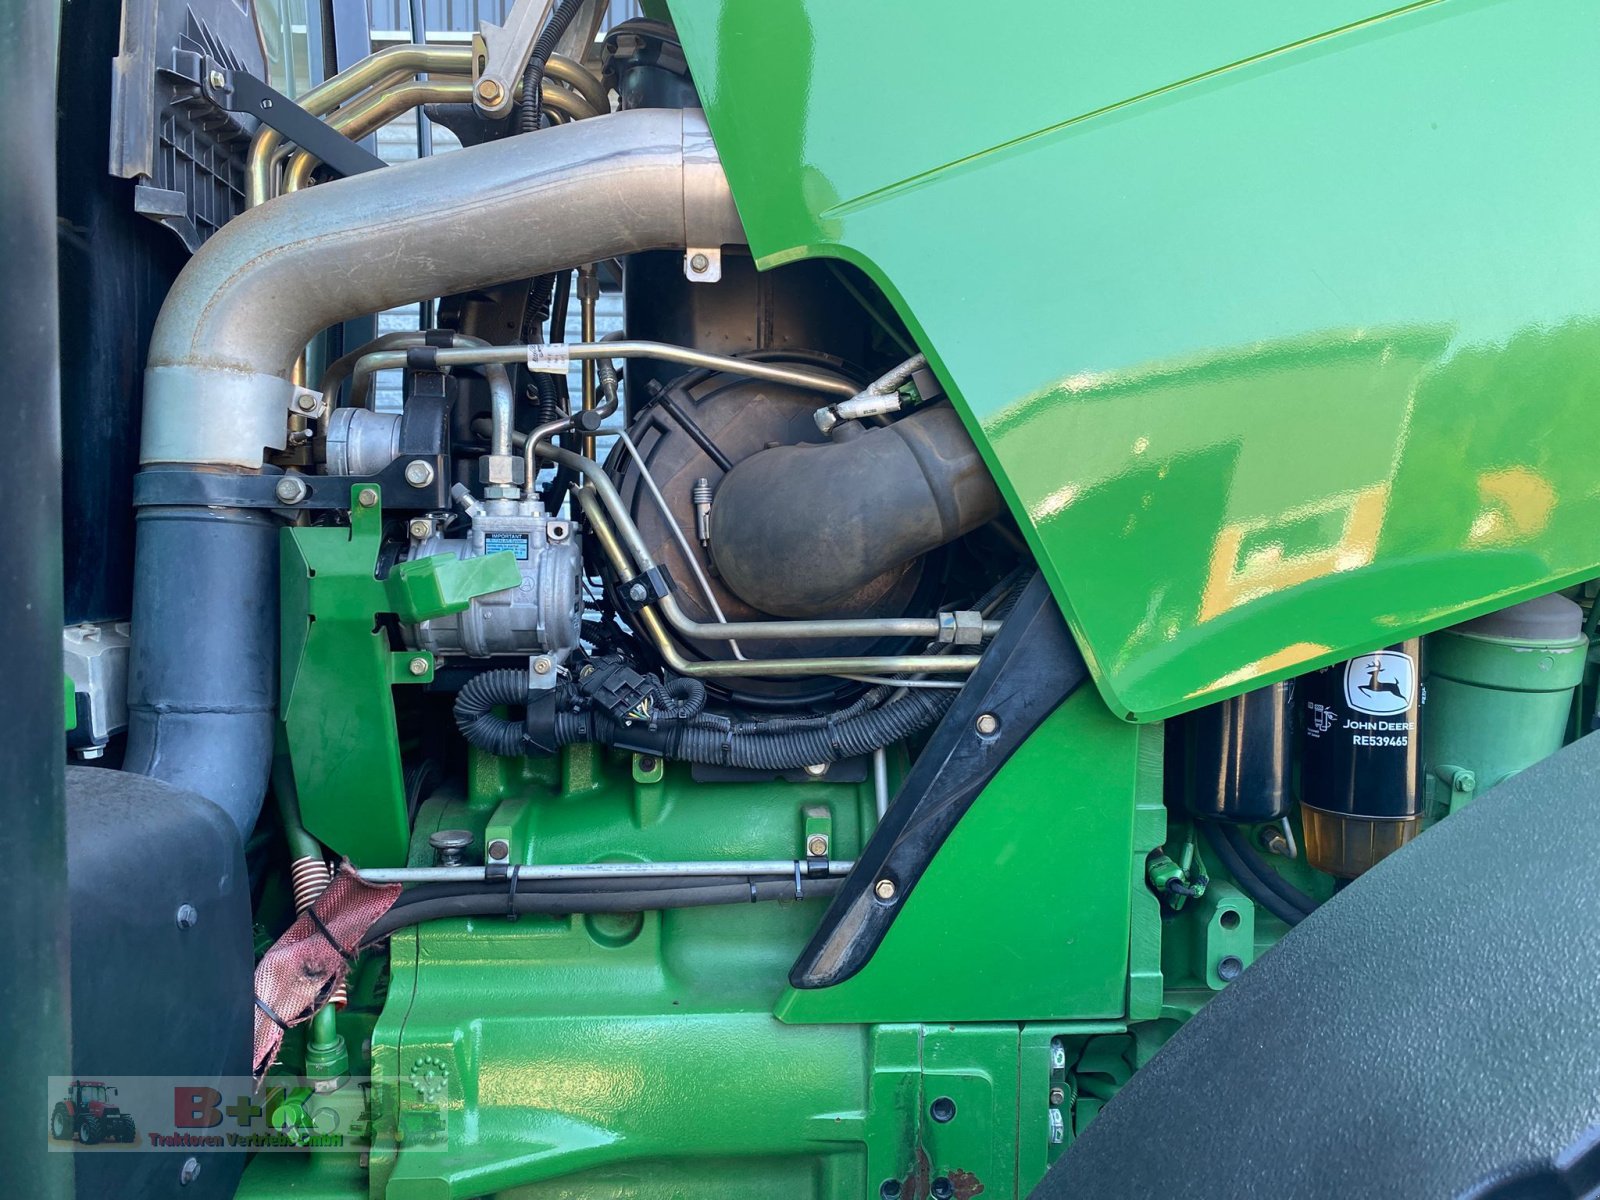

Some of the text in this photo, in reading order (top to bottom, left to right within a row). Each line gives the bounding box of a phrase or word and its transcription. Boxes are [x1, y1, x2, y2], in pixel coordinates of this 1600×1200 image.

[1343, 719, 1415, 731] JOHN DEERE
[1353, 735, 1408, 747] RE539465
